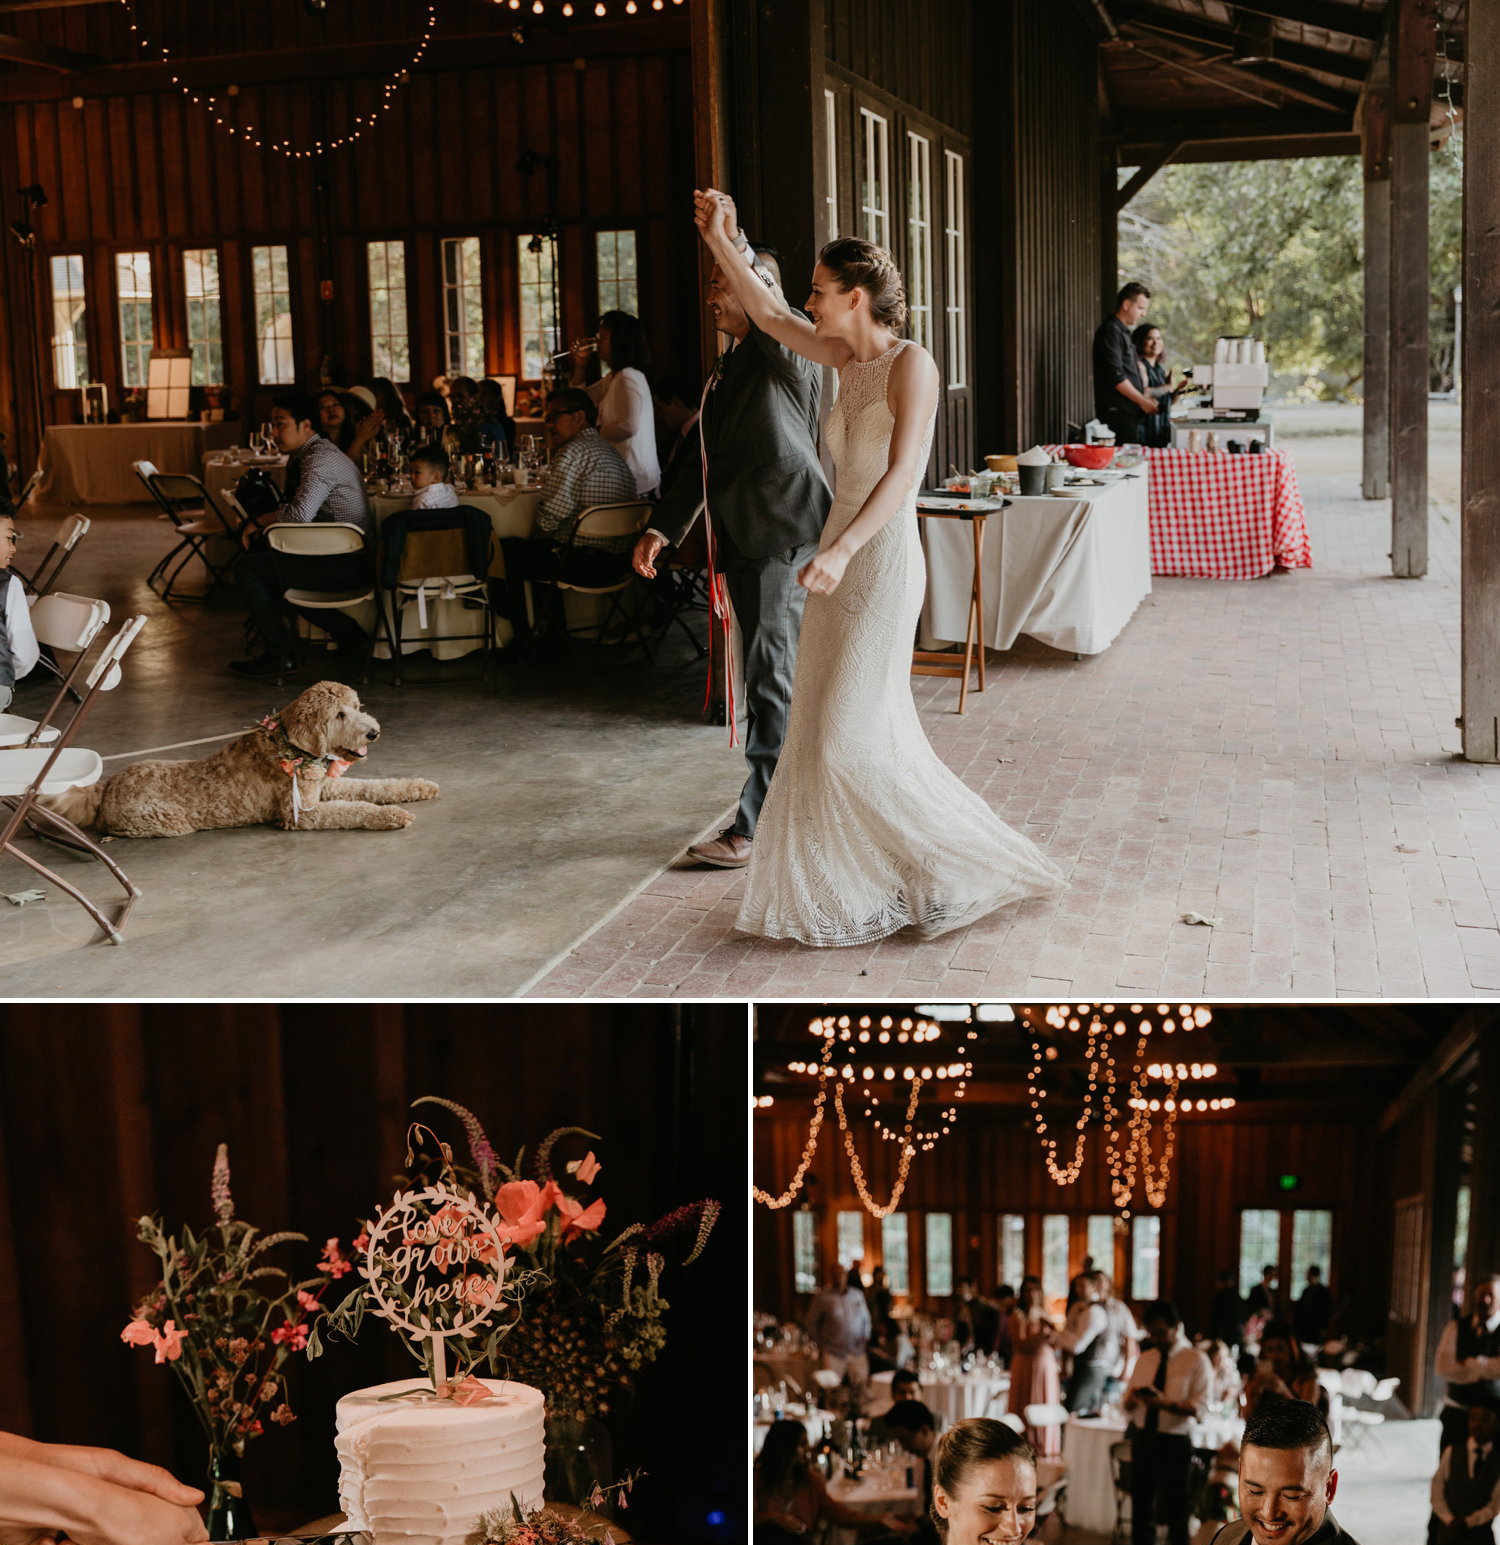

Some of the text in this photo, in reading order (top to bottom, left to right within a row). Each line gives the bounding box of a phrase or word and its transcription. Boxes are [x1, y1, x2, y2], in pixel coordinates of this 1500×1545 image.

[386, 1208, 475, 1242] love
[379, 1238, 490, 1285] grows
[394, 1274, 493, 1311] here
